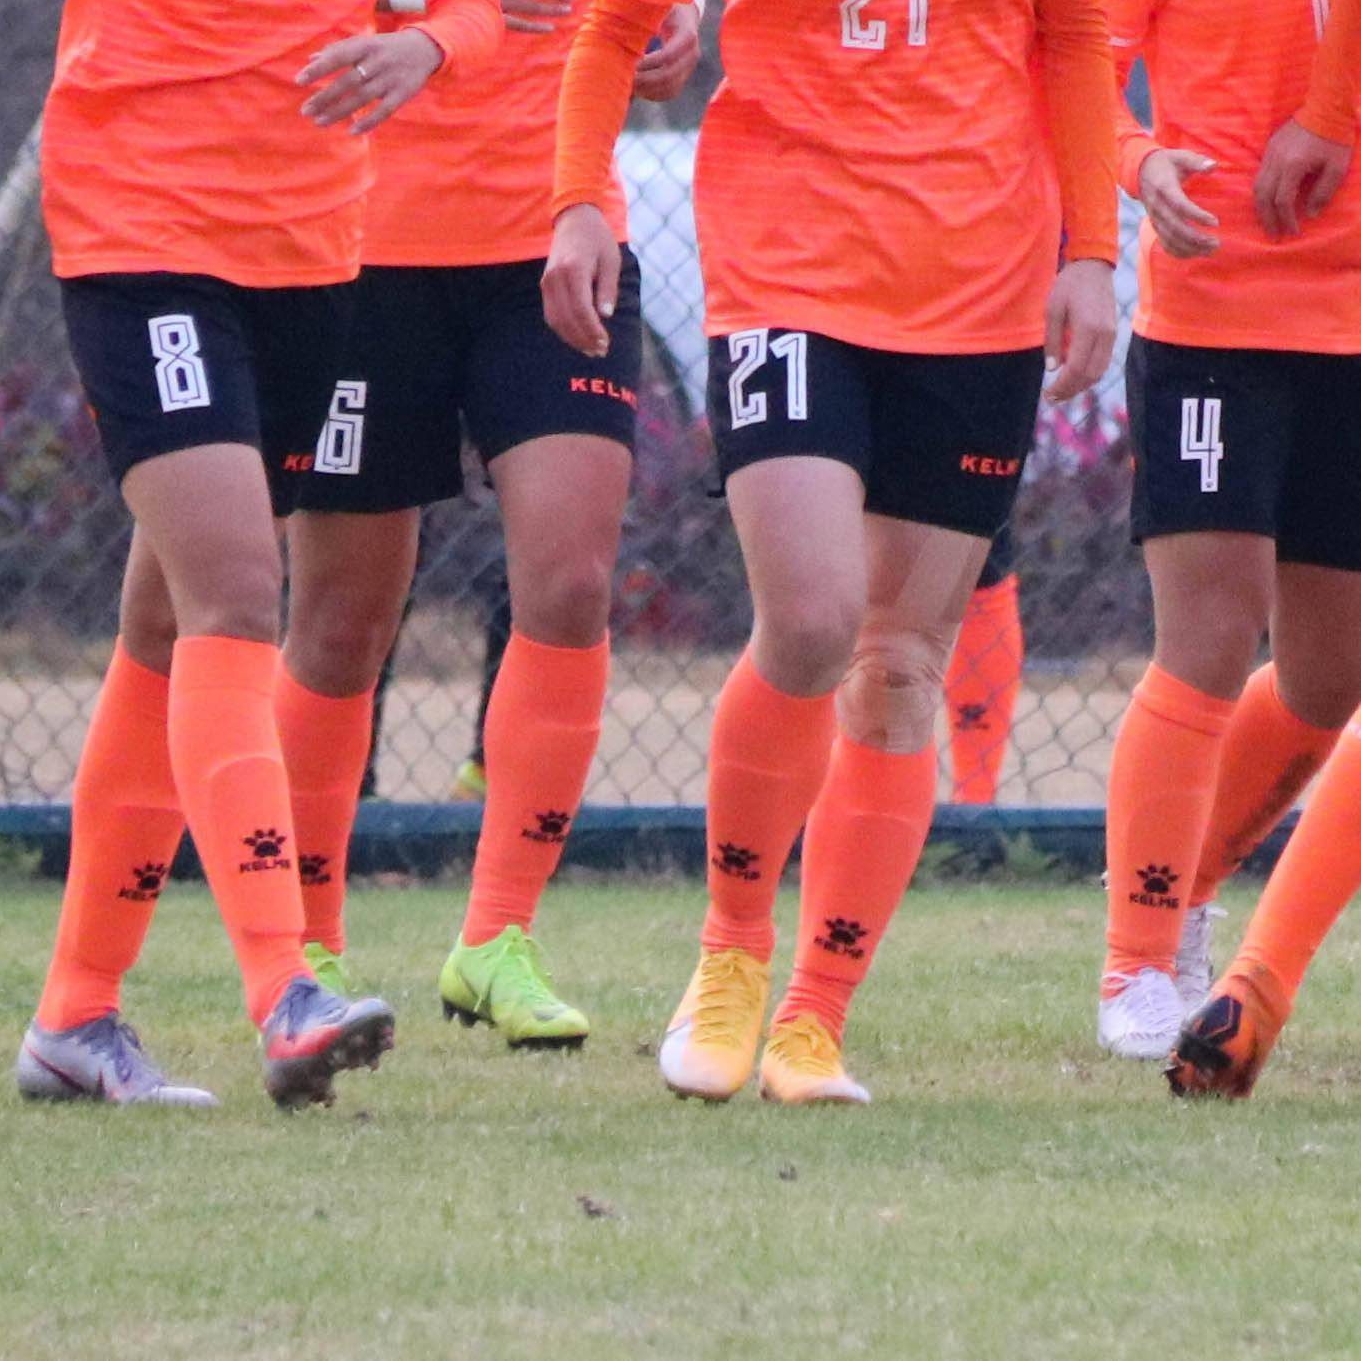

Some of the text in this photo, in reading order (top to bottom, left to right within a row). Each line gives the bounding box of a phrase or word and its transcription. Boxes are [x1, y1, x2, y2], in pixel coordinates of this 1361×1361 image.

[148, 314, 210, 413] 8
[728, 328, 807, 430] 21
[1180, 398, 1223, 492] 4
[1129, 892, 1180, 909] KELME
